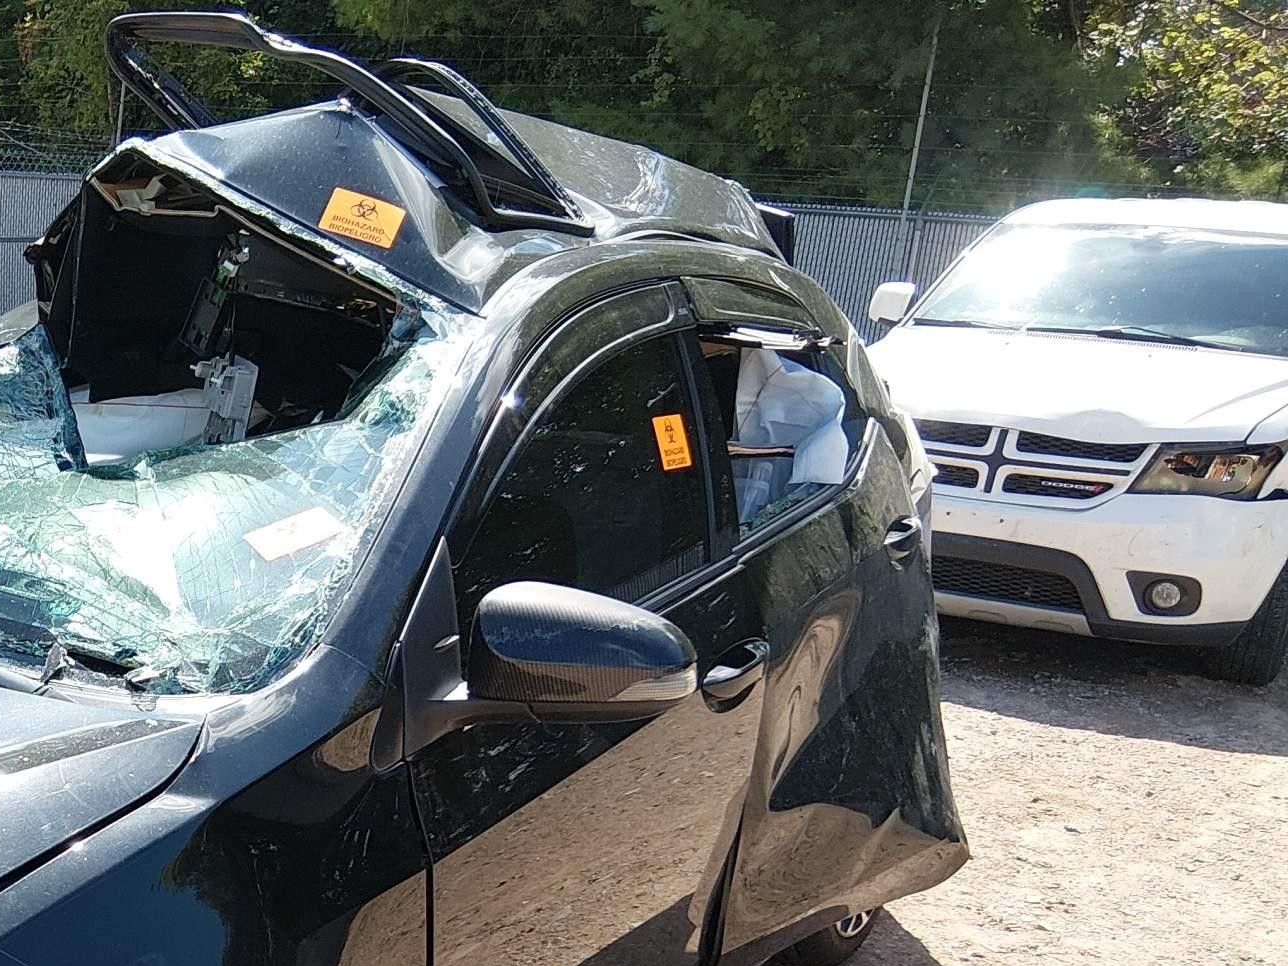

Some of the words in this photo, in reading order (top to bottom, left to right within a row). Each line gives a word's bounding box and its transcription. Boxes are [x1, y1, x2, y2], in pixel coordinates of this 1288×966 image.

[328, 223, 382, 243] BIOPELIGRO
[333, 215, 386, 235] BIOHAZARD
[1041, 480, 1095, 491] DODGE
